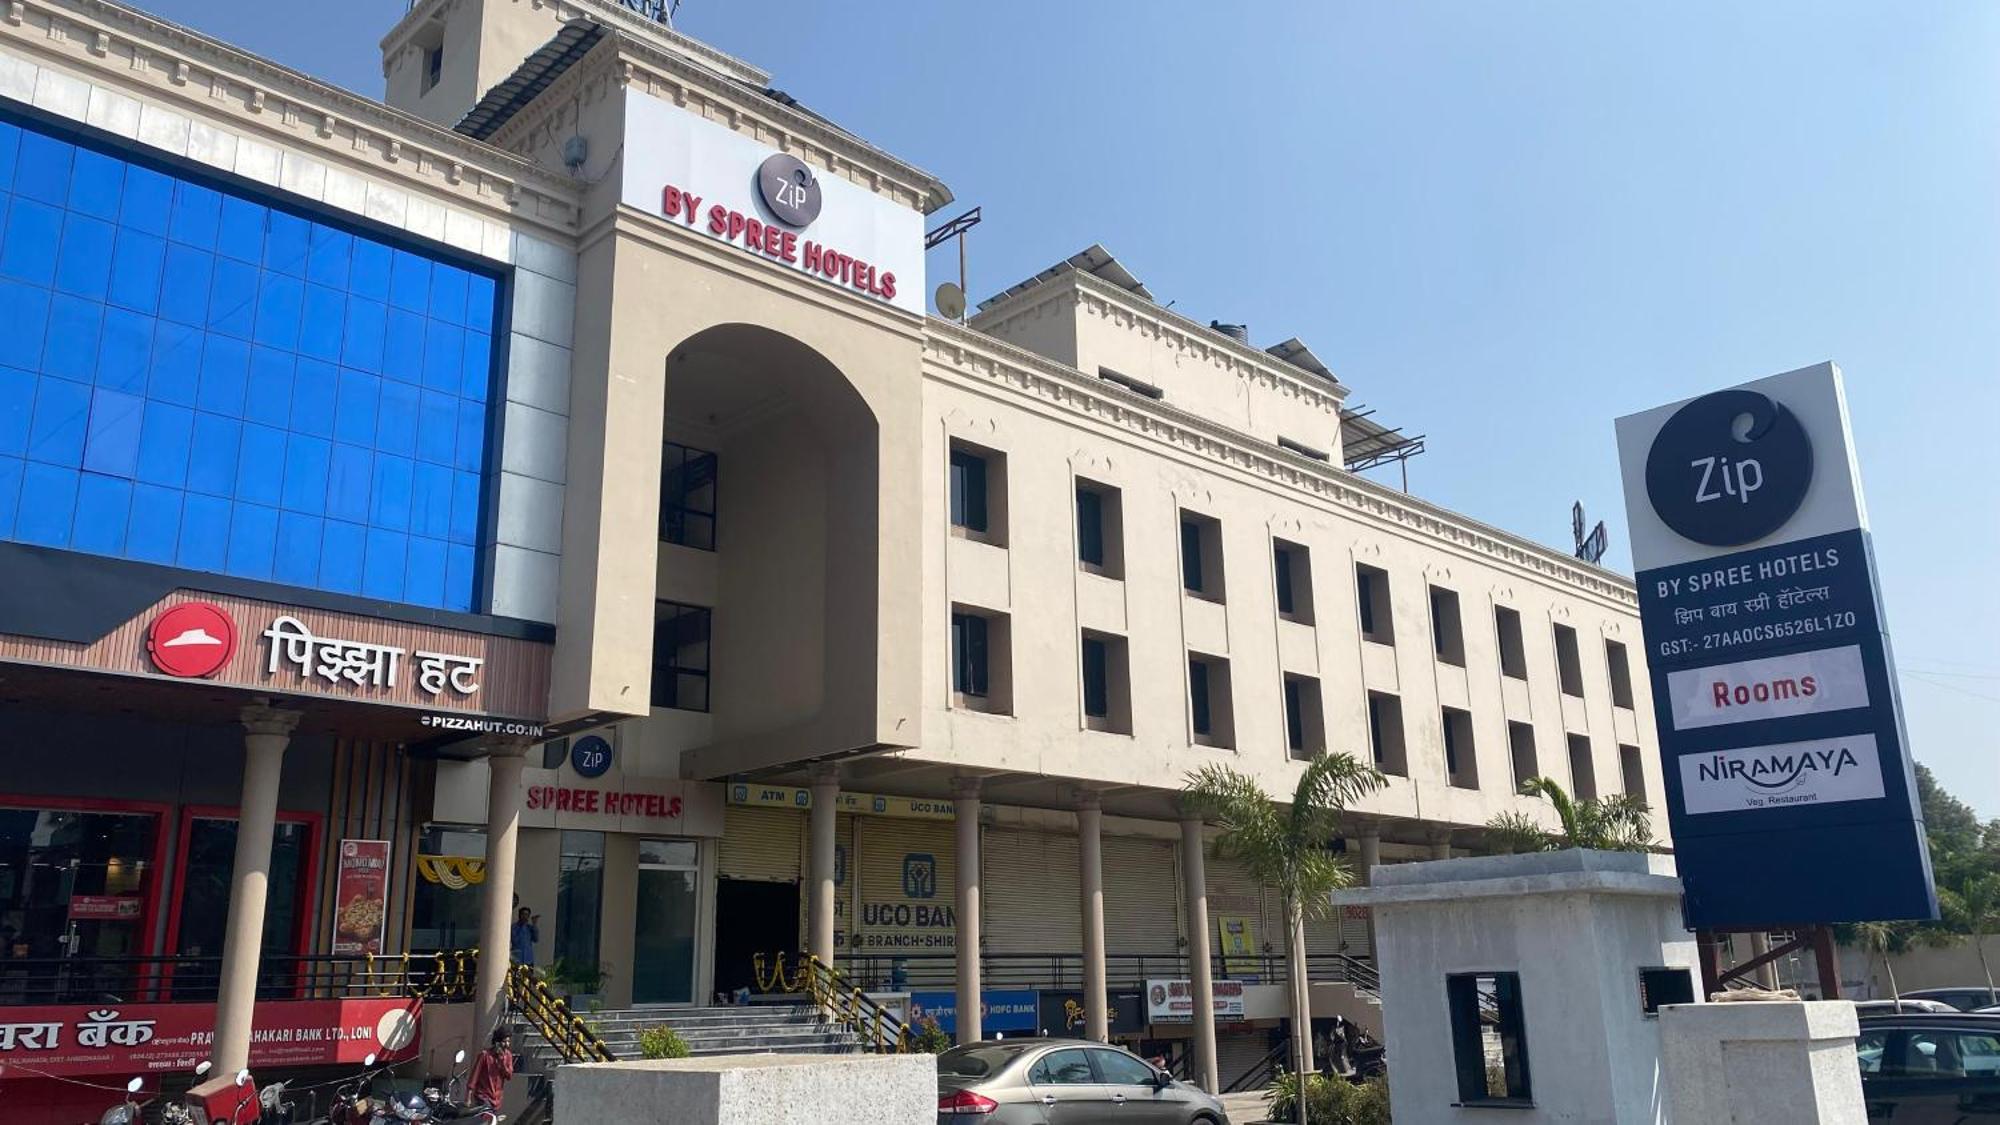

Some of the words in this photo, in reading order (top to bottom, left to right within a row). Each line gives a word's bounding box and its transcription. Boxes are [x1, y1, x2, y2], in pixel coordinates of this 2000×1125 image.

[662, 184, 702, 224] BY
[708, 205, 796, 262] SPREE
[804, 241, 896, 299] HOTELS
[1691, 456, 1763, 504] Zip
[1657, 577, 1681, 598] BY
[1688, 565, 1753, 593] SPREE
[1758, 548, 1840, 580] HOTELS
[1674, 607, 1704, 626] झिप
[1709, 601, 1738, 619] बाय
[264, 615, 406, 687] पिझ्झा
[415, 649, 484, 694] हट
[1712, 675, 1817, 708] Rooms
[432, 716, 543, 737] PIZZAHUT.CO.IN
[526, 785, 599, 814] SPREE
[604, 791, 682, 818] HOTELS
[760, 790, 785, 801] ATM
[911, 801, 931, 813] UCO
[1768, 793, 1817, 804] Restaurant
[863, 903, 911, 927] UCO
[990, 1004, 1012, 1014] HDFC
[1013, 1004, 1036, 1013] BANK
[296, 1028, 323, 1042] BANK
[351, 1026, 372, 1040] LONI
